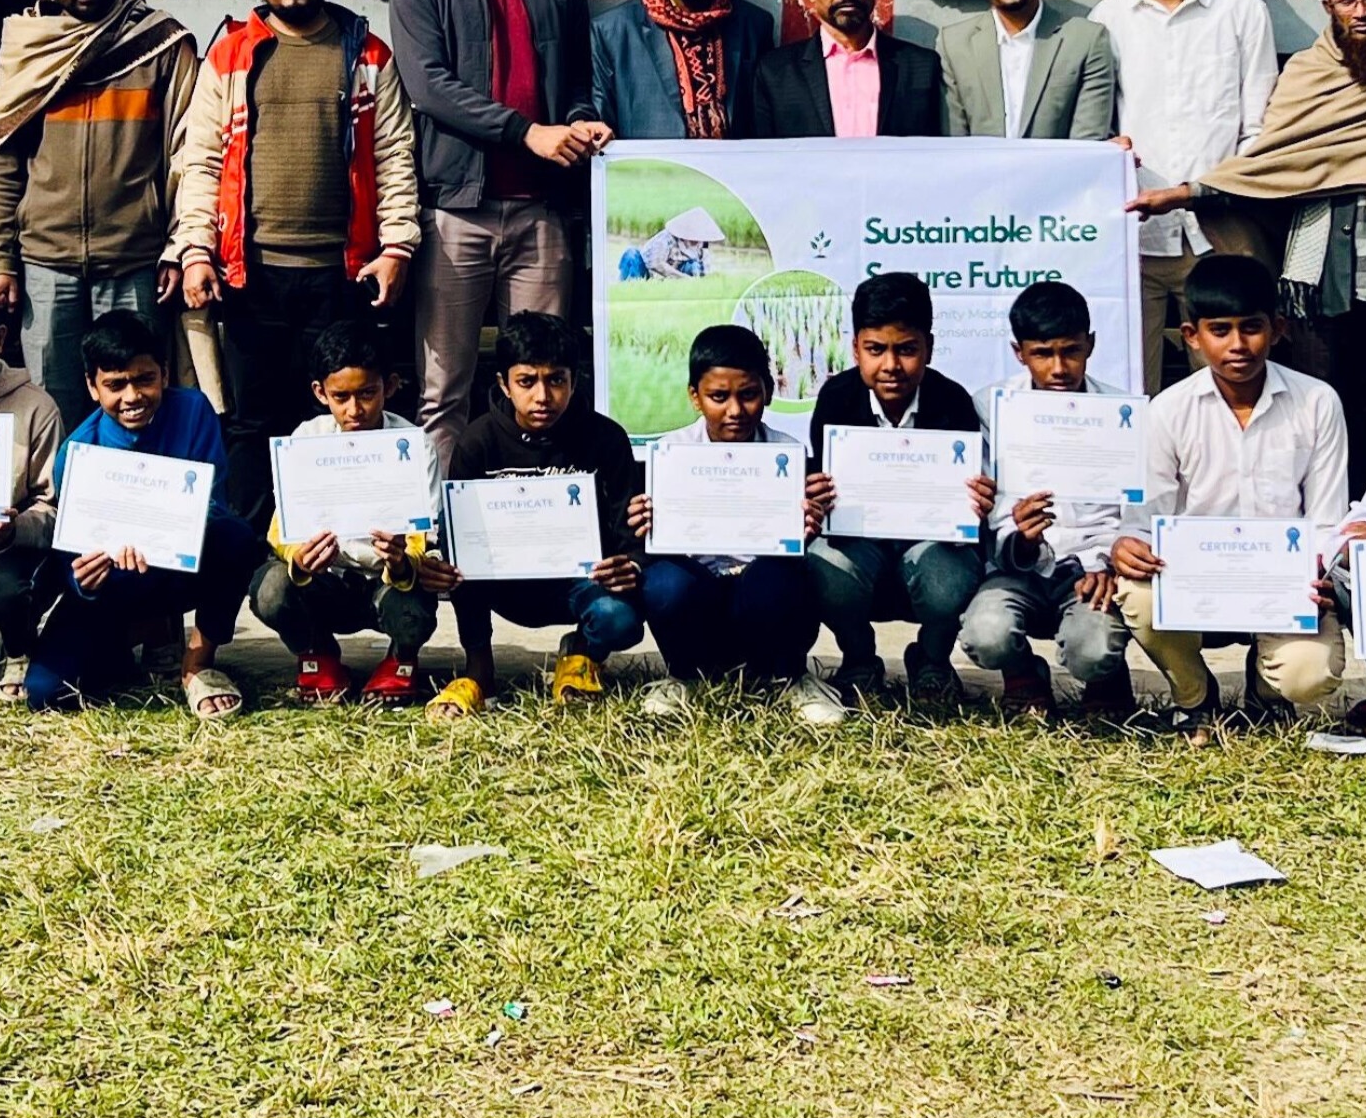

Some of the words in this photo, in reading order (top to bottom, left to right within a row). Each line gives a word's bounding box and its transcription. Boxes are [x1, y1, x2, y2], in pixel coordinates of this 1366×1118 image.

[863, 215, 1032, 245] Sustainable
[1038, 215, 1097, 242] Rice
[866, 261, 962, 289] Sure
[968, 261, 1063, 288] Future
[1033, 415, 1104, 426] CERTIFICATE
[315, 453, 383, 466] CERTIFICATE
[868, 452, 938, 463] CERTIFICATE
[690, 466, 760, 477] CERTIFICATE
[104, 471, 169, 490] CERTIFICATE
[486, 498, 553, 510] CERTIFICATE
[1199, 541, 1271, 552] CERTIFICATE
